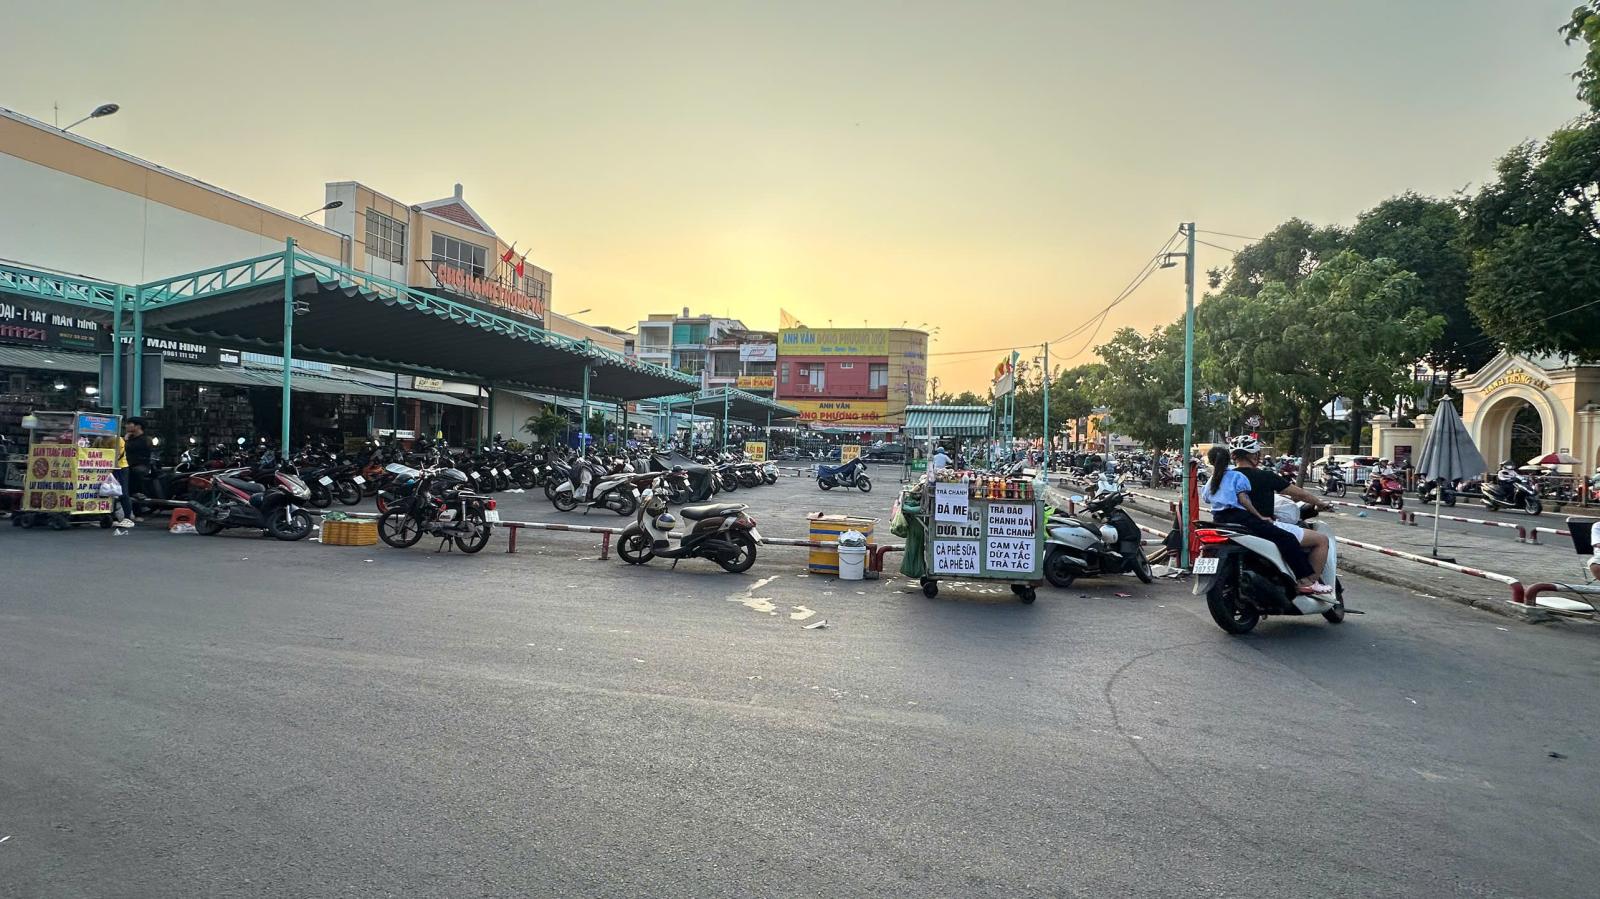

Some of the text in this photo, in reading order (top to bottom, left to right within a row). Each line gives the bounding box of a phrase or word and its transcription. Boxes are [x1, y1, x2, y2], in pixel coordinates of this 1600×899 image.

[799, 410, 817, 420] ÔNG
[953, 505, 967, 516] ME
[989, 516, 1016, 526] CHANH
[1006, 527, 1034, 537] CHANH
[936, 543, 977, 556] CÀ PHÊ SỮA
[990, 541, 1010, 549] CAM
[938, 558, 948, 570] CÀ
[949, 558, 964, 570] PHÊ
